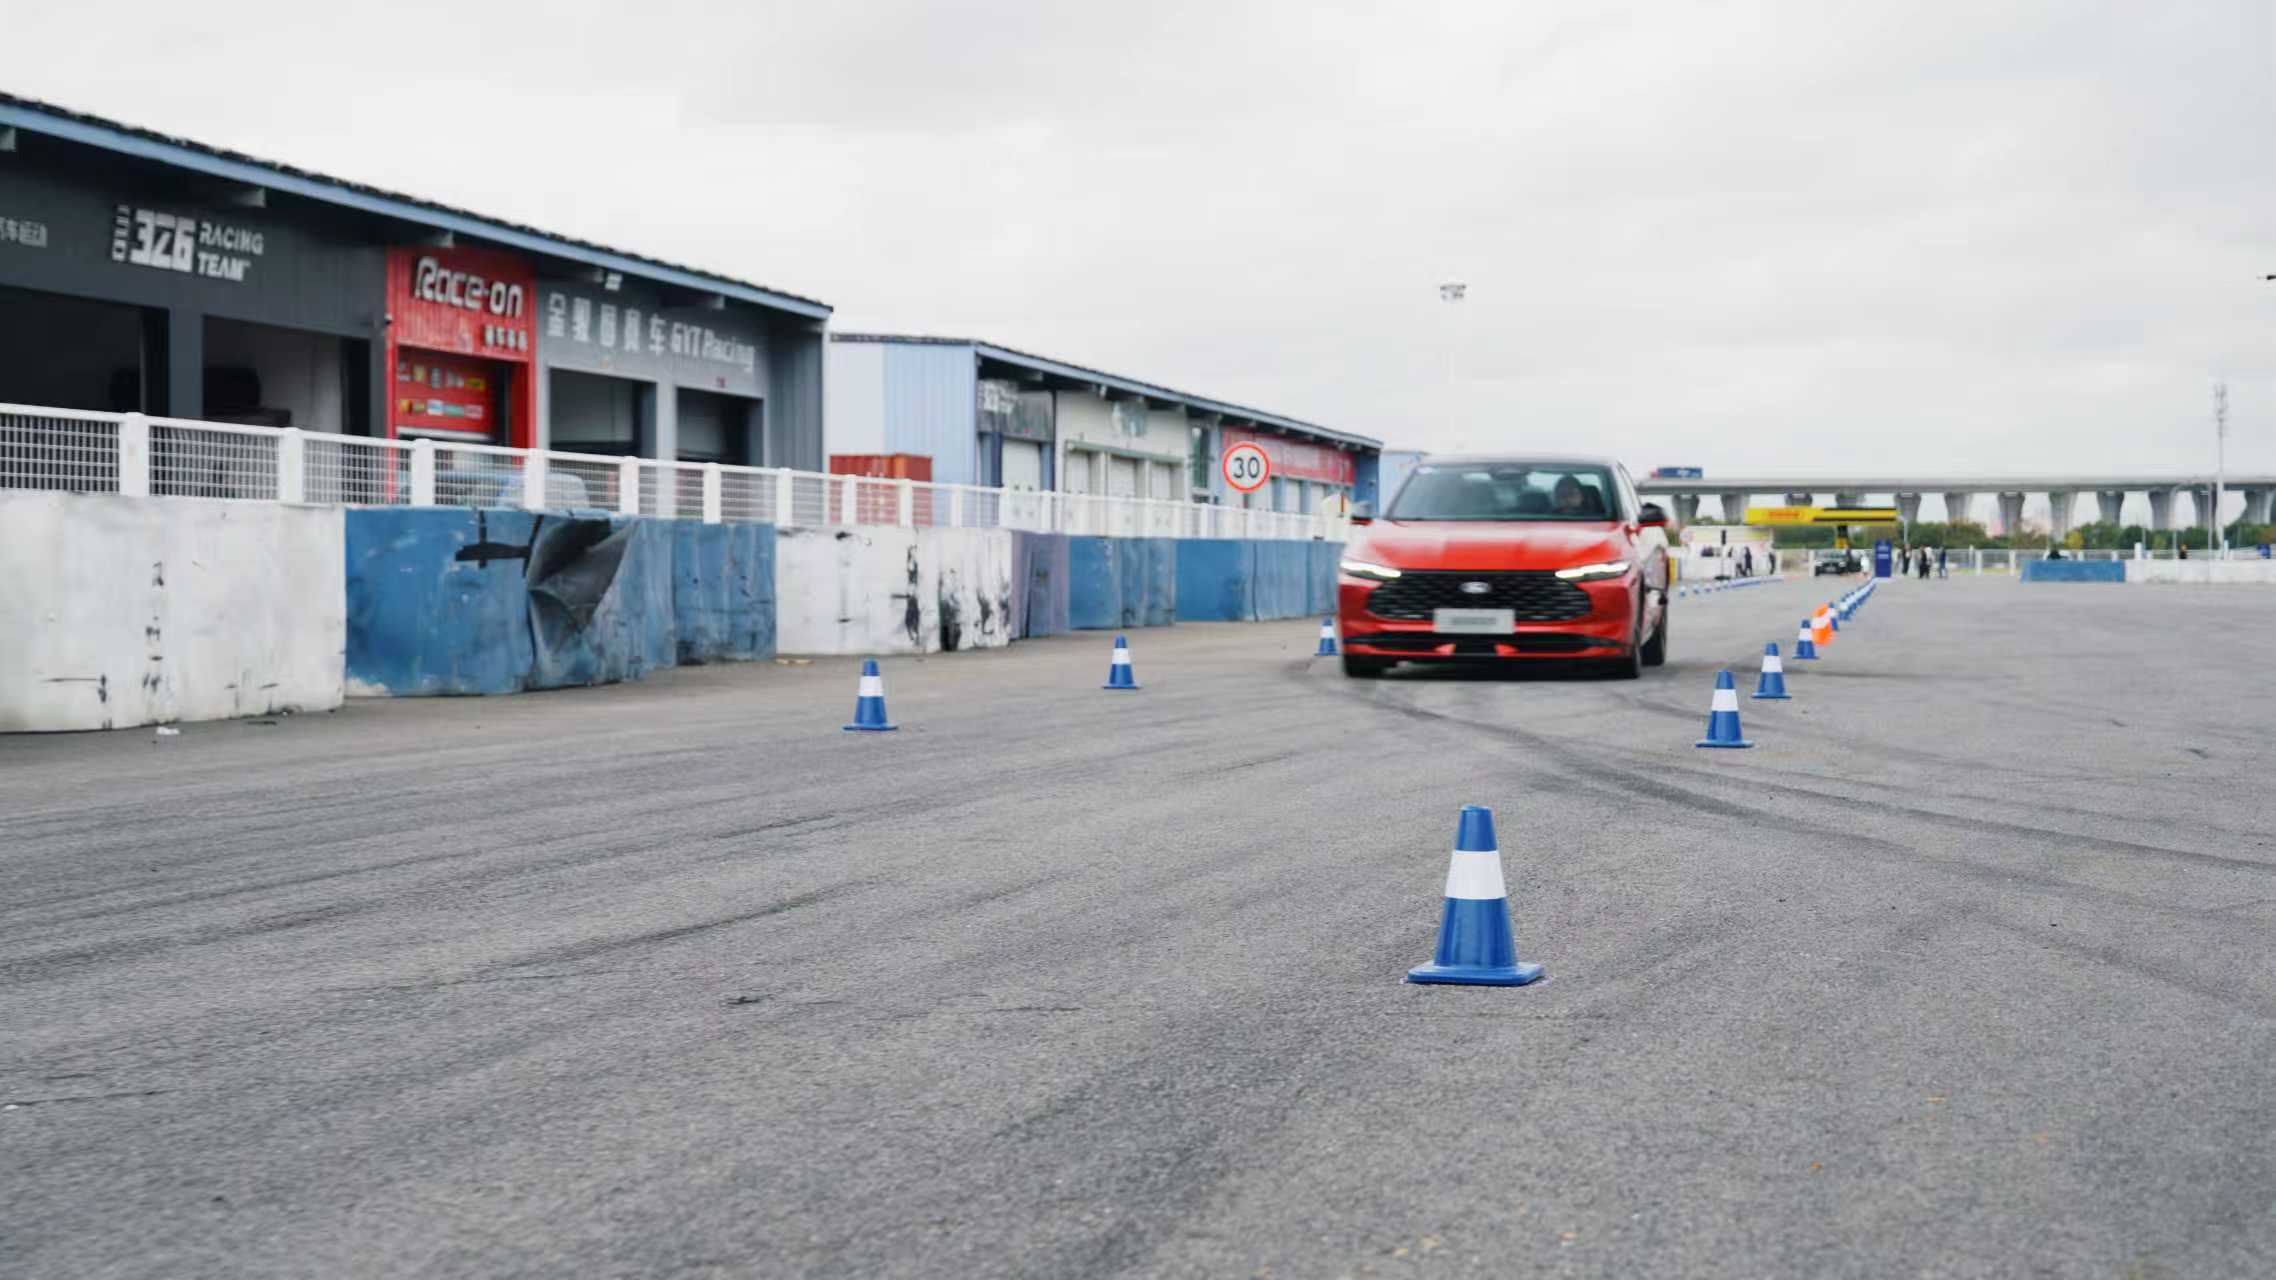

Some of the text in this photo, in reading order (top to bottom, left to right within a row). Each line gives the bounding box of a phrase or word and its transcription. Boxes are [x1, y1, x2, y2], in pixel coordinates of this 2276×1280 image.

[130, 208, 196, 273] 326
[199, 221, 264, 255] RACING
[1233, 456, 1260, 479] 30
